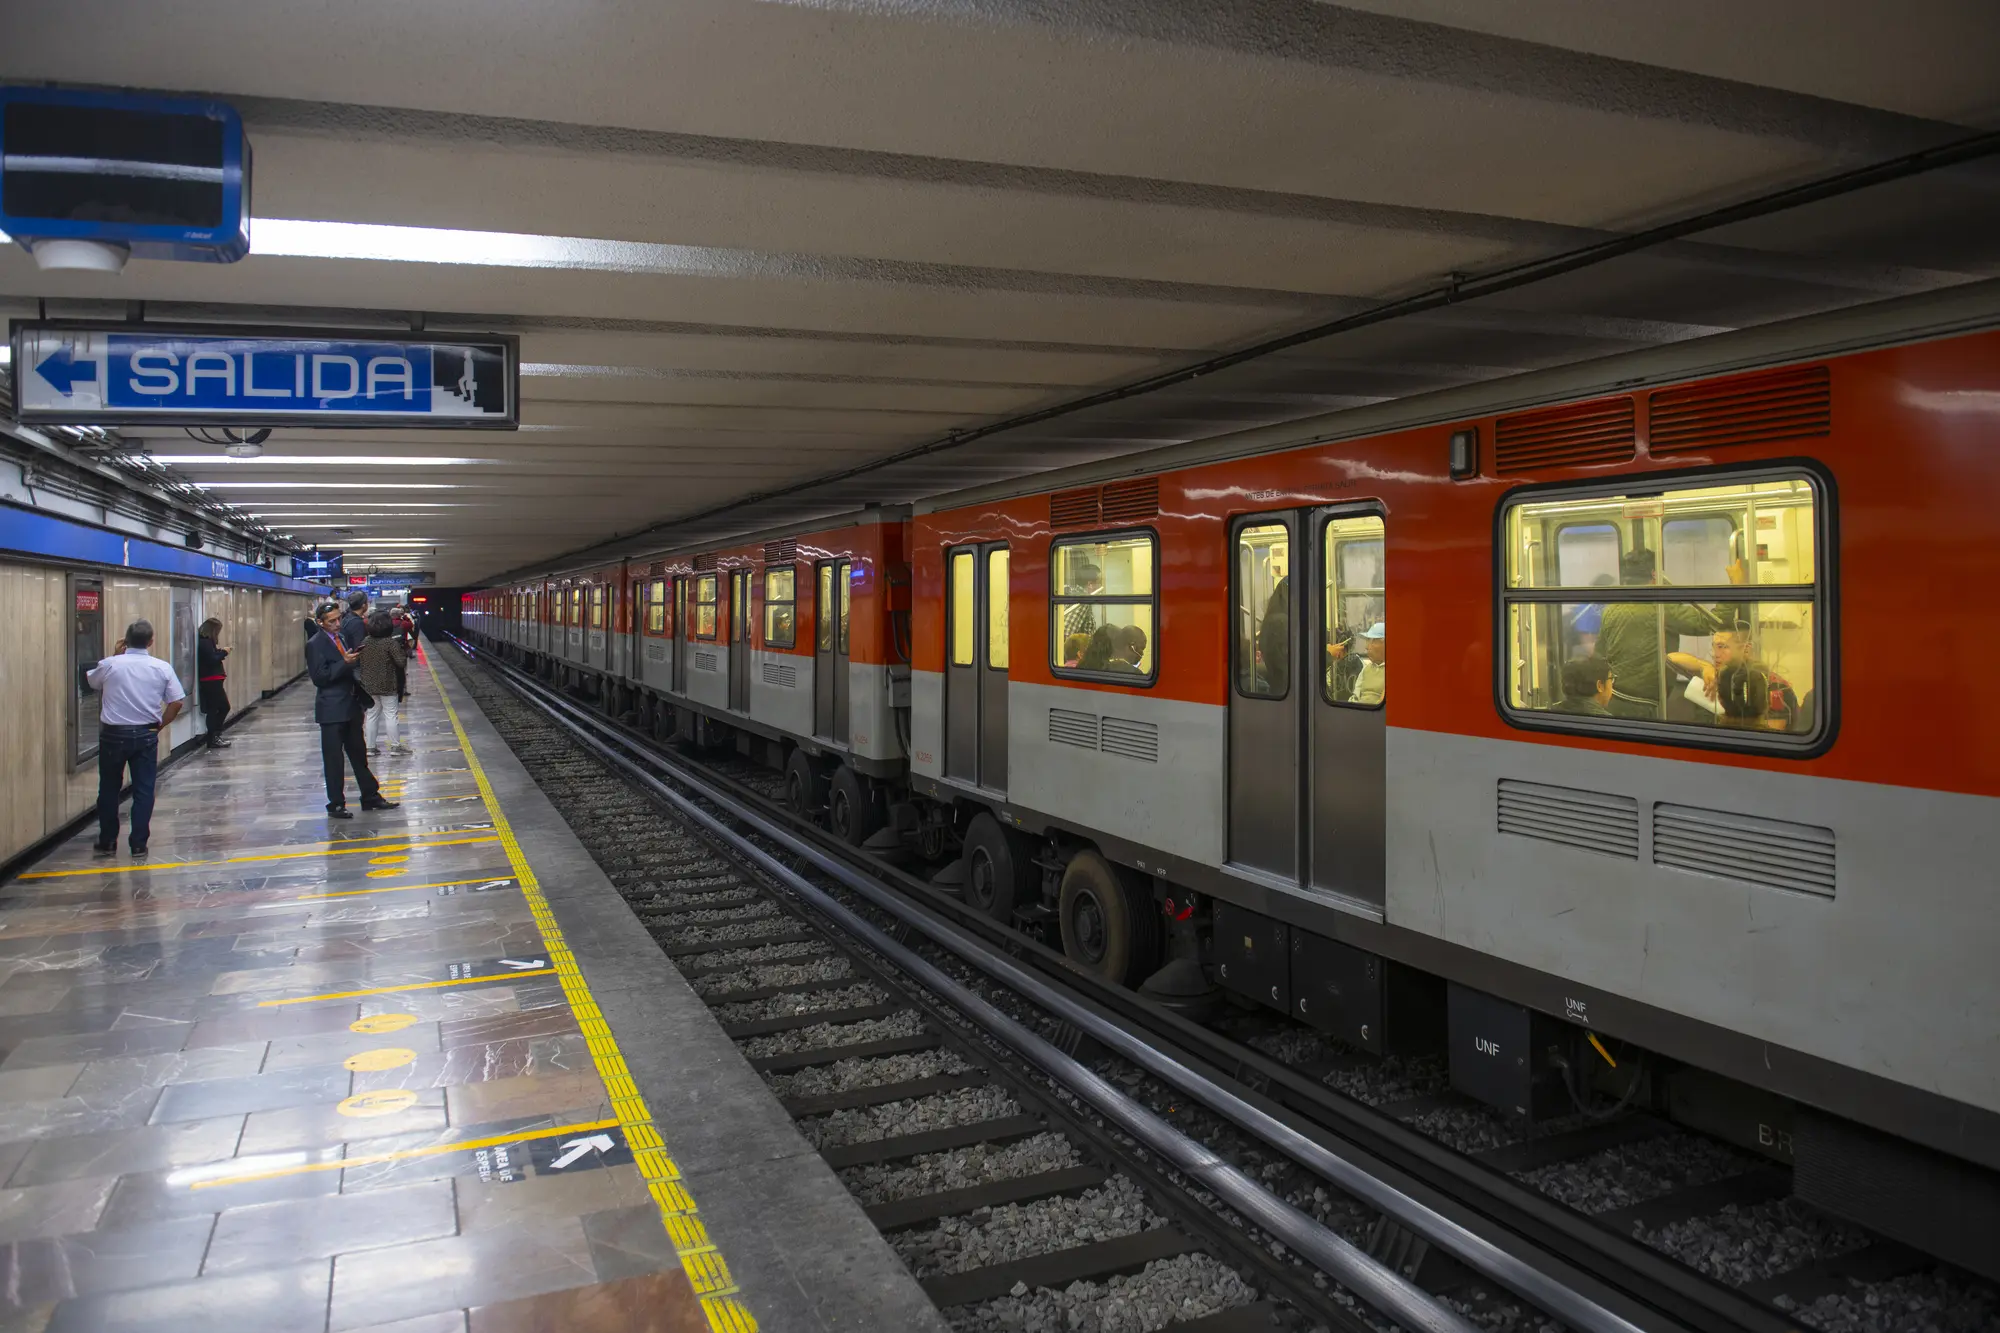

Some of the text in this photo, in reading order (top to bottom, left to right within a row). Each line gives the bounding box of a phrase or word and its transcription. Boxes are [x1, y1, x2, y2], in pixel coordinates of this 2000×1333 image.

[128, 349, 414, 401] SALIDA
[1265, 489, 1275, 498] DE
[1565, 996, 1587, 1013] UNF
[1475, 1036, 1500, 1057] UNF
[475, 1150, 492, 1183] ESPERA
[494, 1146, 513, 1183] AREA DE
